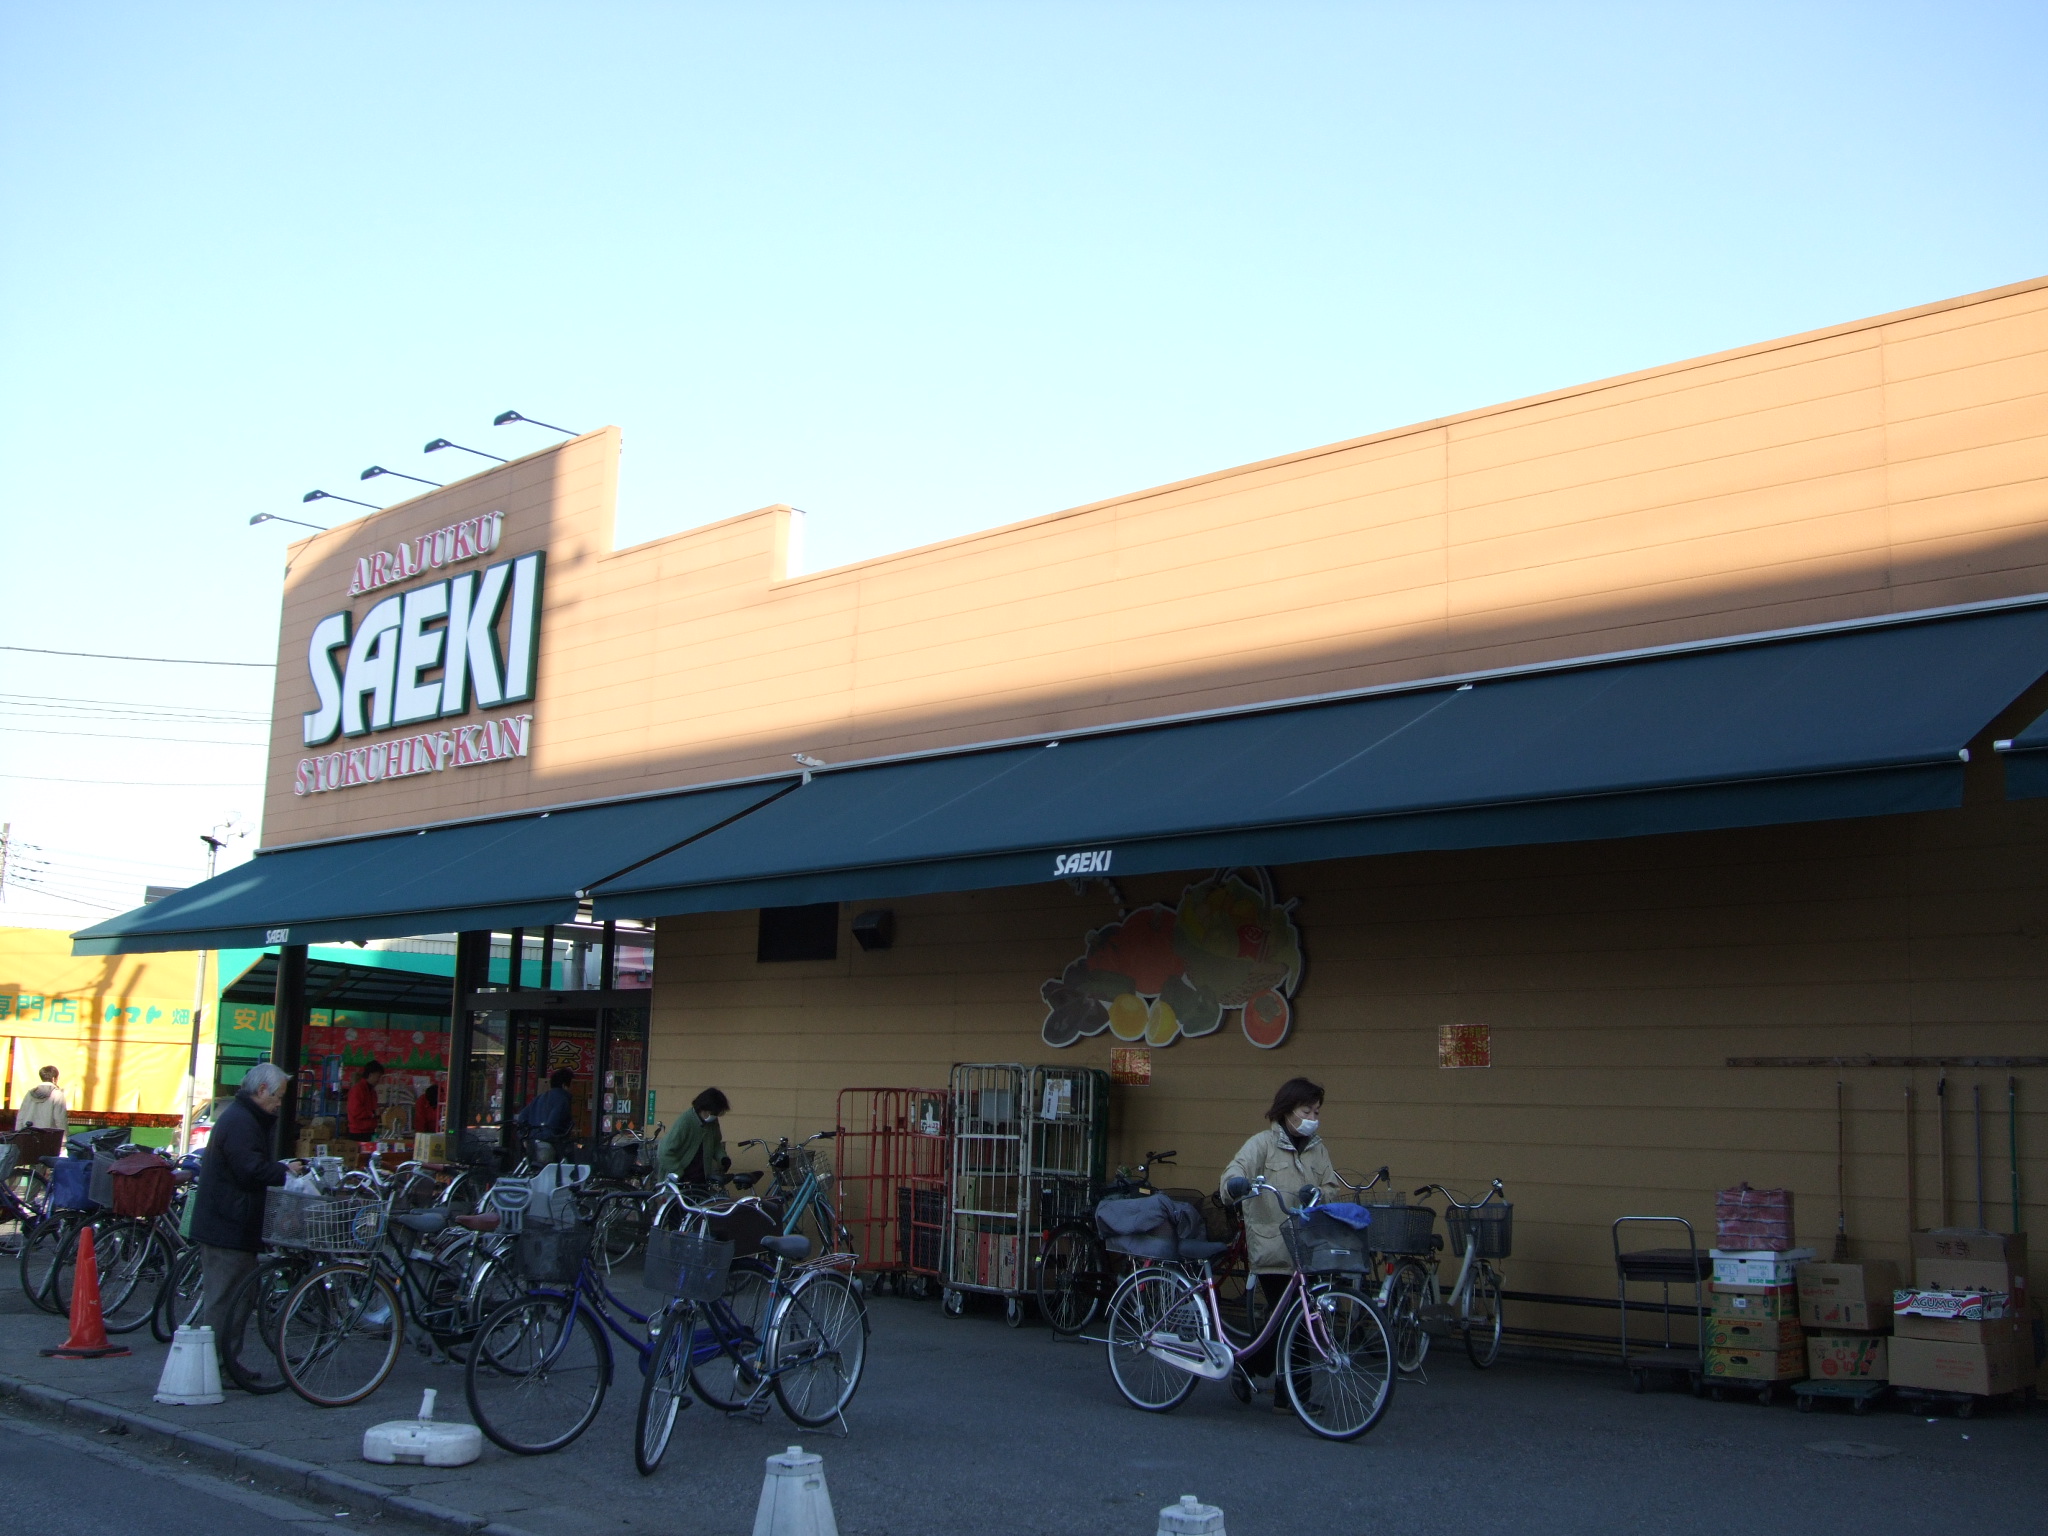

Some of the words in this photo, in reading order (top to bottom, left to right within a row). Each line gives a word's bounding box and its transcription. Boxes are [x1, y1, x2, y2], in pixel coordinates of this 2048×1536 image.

[347, 511, 504, 597] ARAJUKU
[303, 550, 546, 748] SAEKI
[1053, 849, 1113, 876] SAEKI
[265, 928, 290, 944] SAEKI
[1909, 1297, 1963, 1311] AGUMEX
